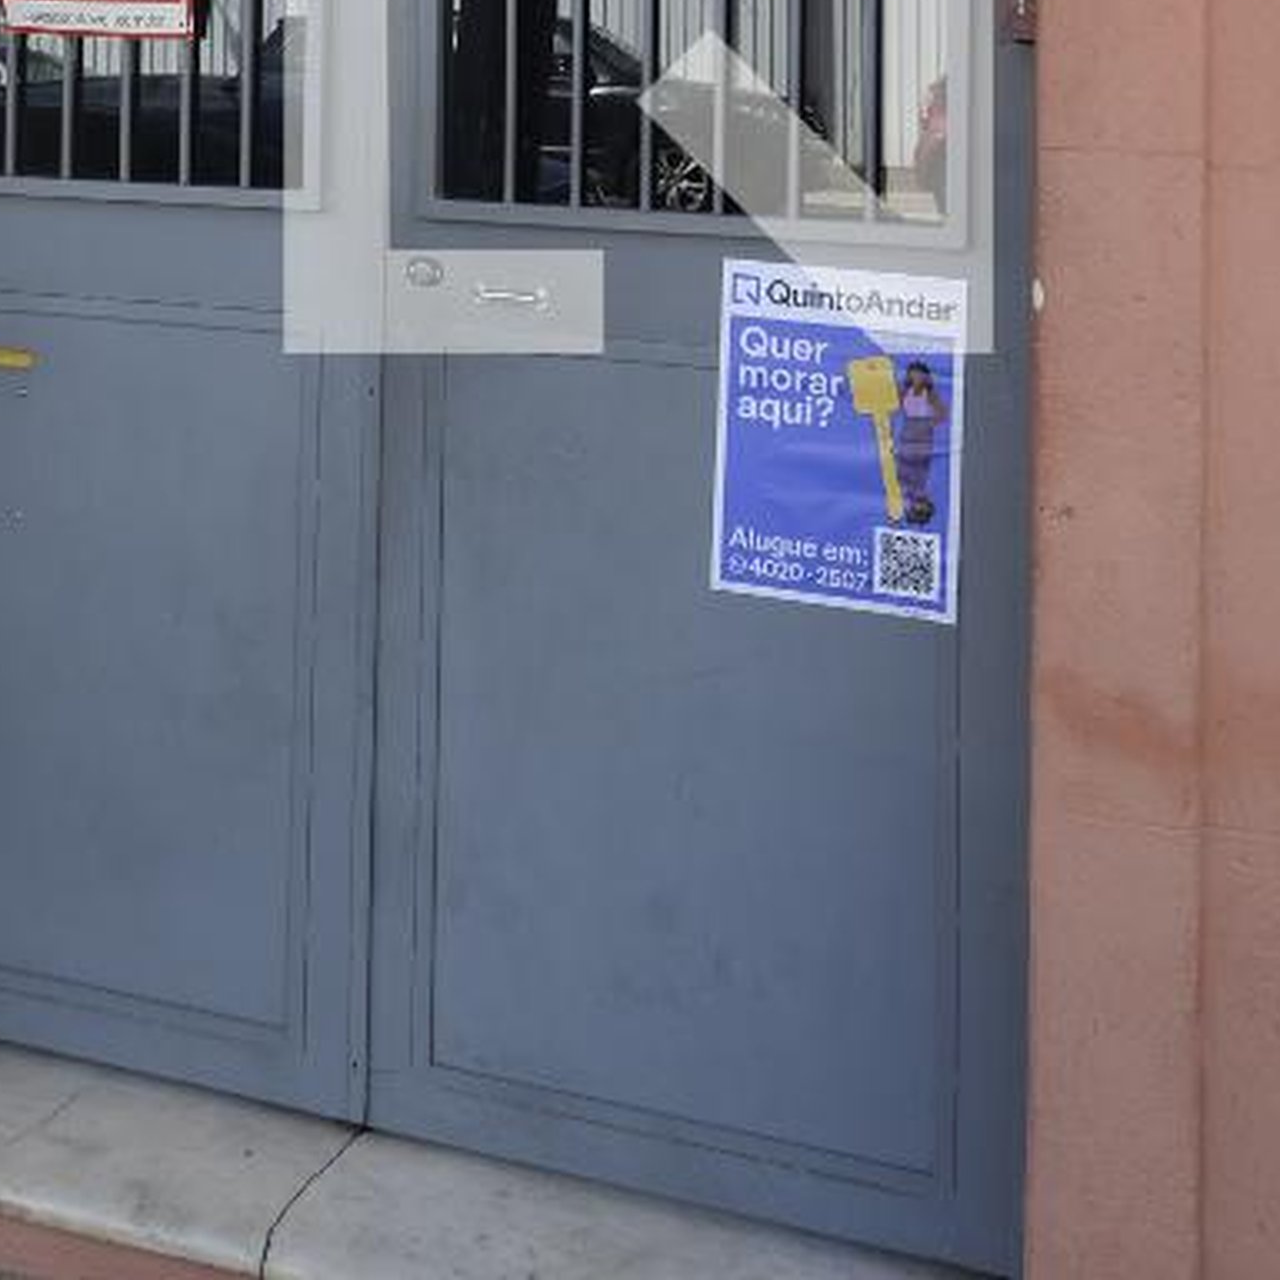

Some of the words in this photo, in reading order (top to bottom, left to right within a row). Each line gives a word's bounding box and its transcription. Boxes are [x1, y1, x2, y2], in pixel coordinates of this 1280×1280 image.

[766, 278, 956, 322] QuintoAndar
[740, 326, 828, 364] Quer
[738, 363, 843, 397] morar
[737, 394, 835, 429] aqui?
[728, 525, 818, 559] Alugue
[822, 542, 869, 567] em:
